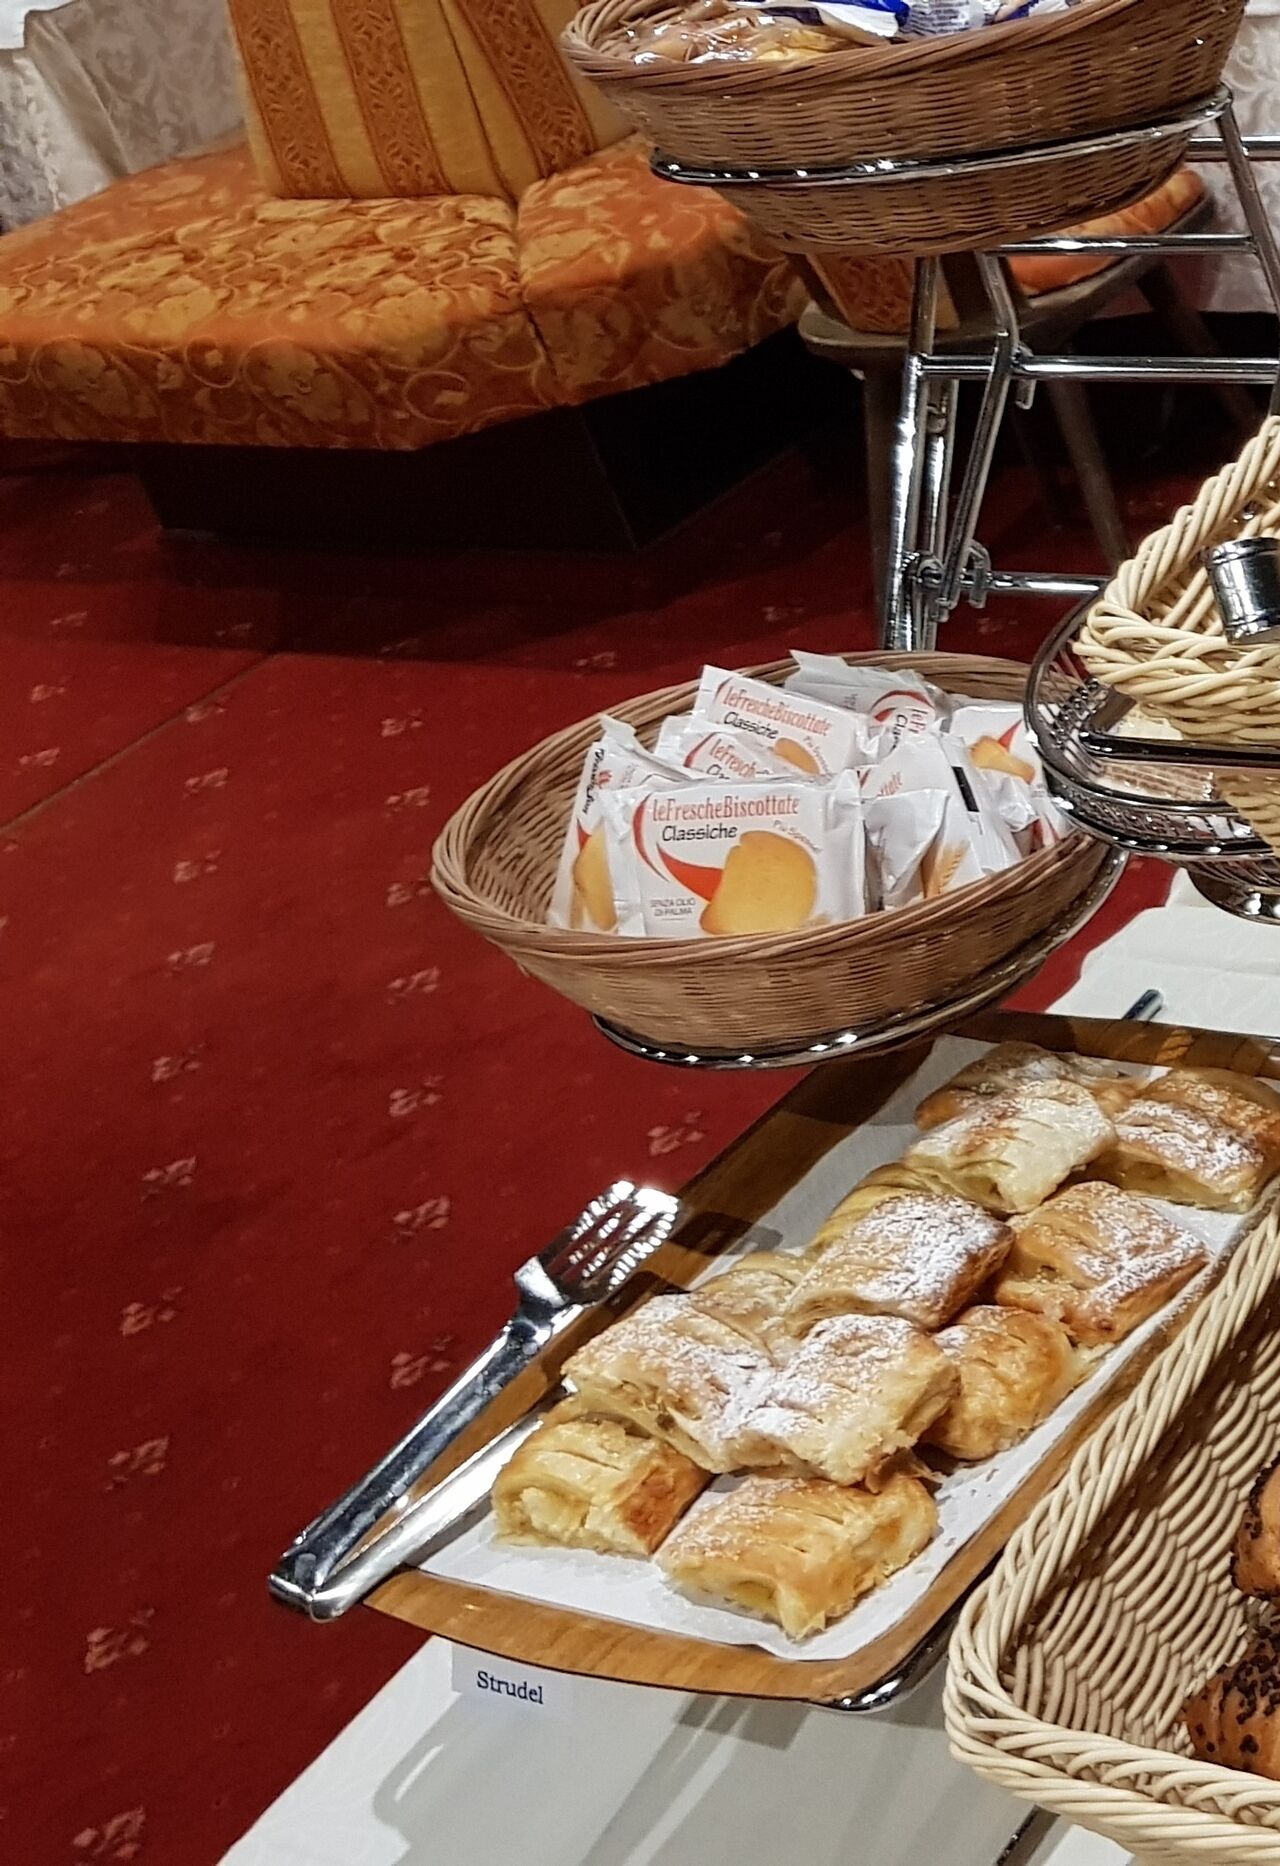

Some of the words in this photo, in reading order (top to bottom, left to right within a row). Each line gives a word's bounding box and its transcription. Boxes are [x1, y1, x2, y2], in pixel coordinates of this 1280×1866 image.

[723, 710, 780, 740] Classiche
[652, 794, 800, 823] leFrescheBiscottate
[662, 822, 738, 842] Classiche
[476, 1670, 544, 1705] Strudel
